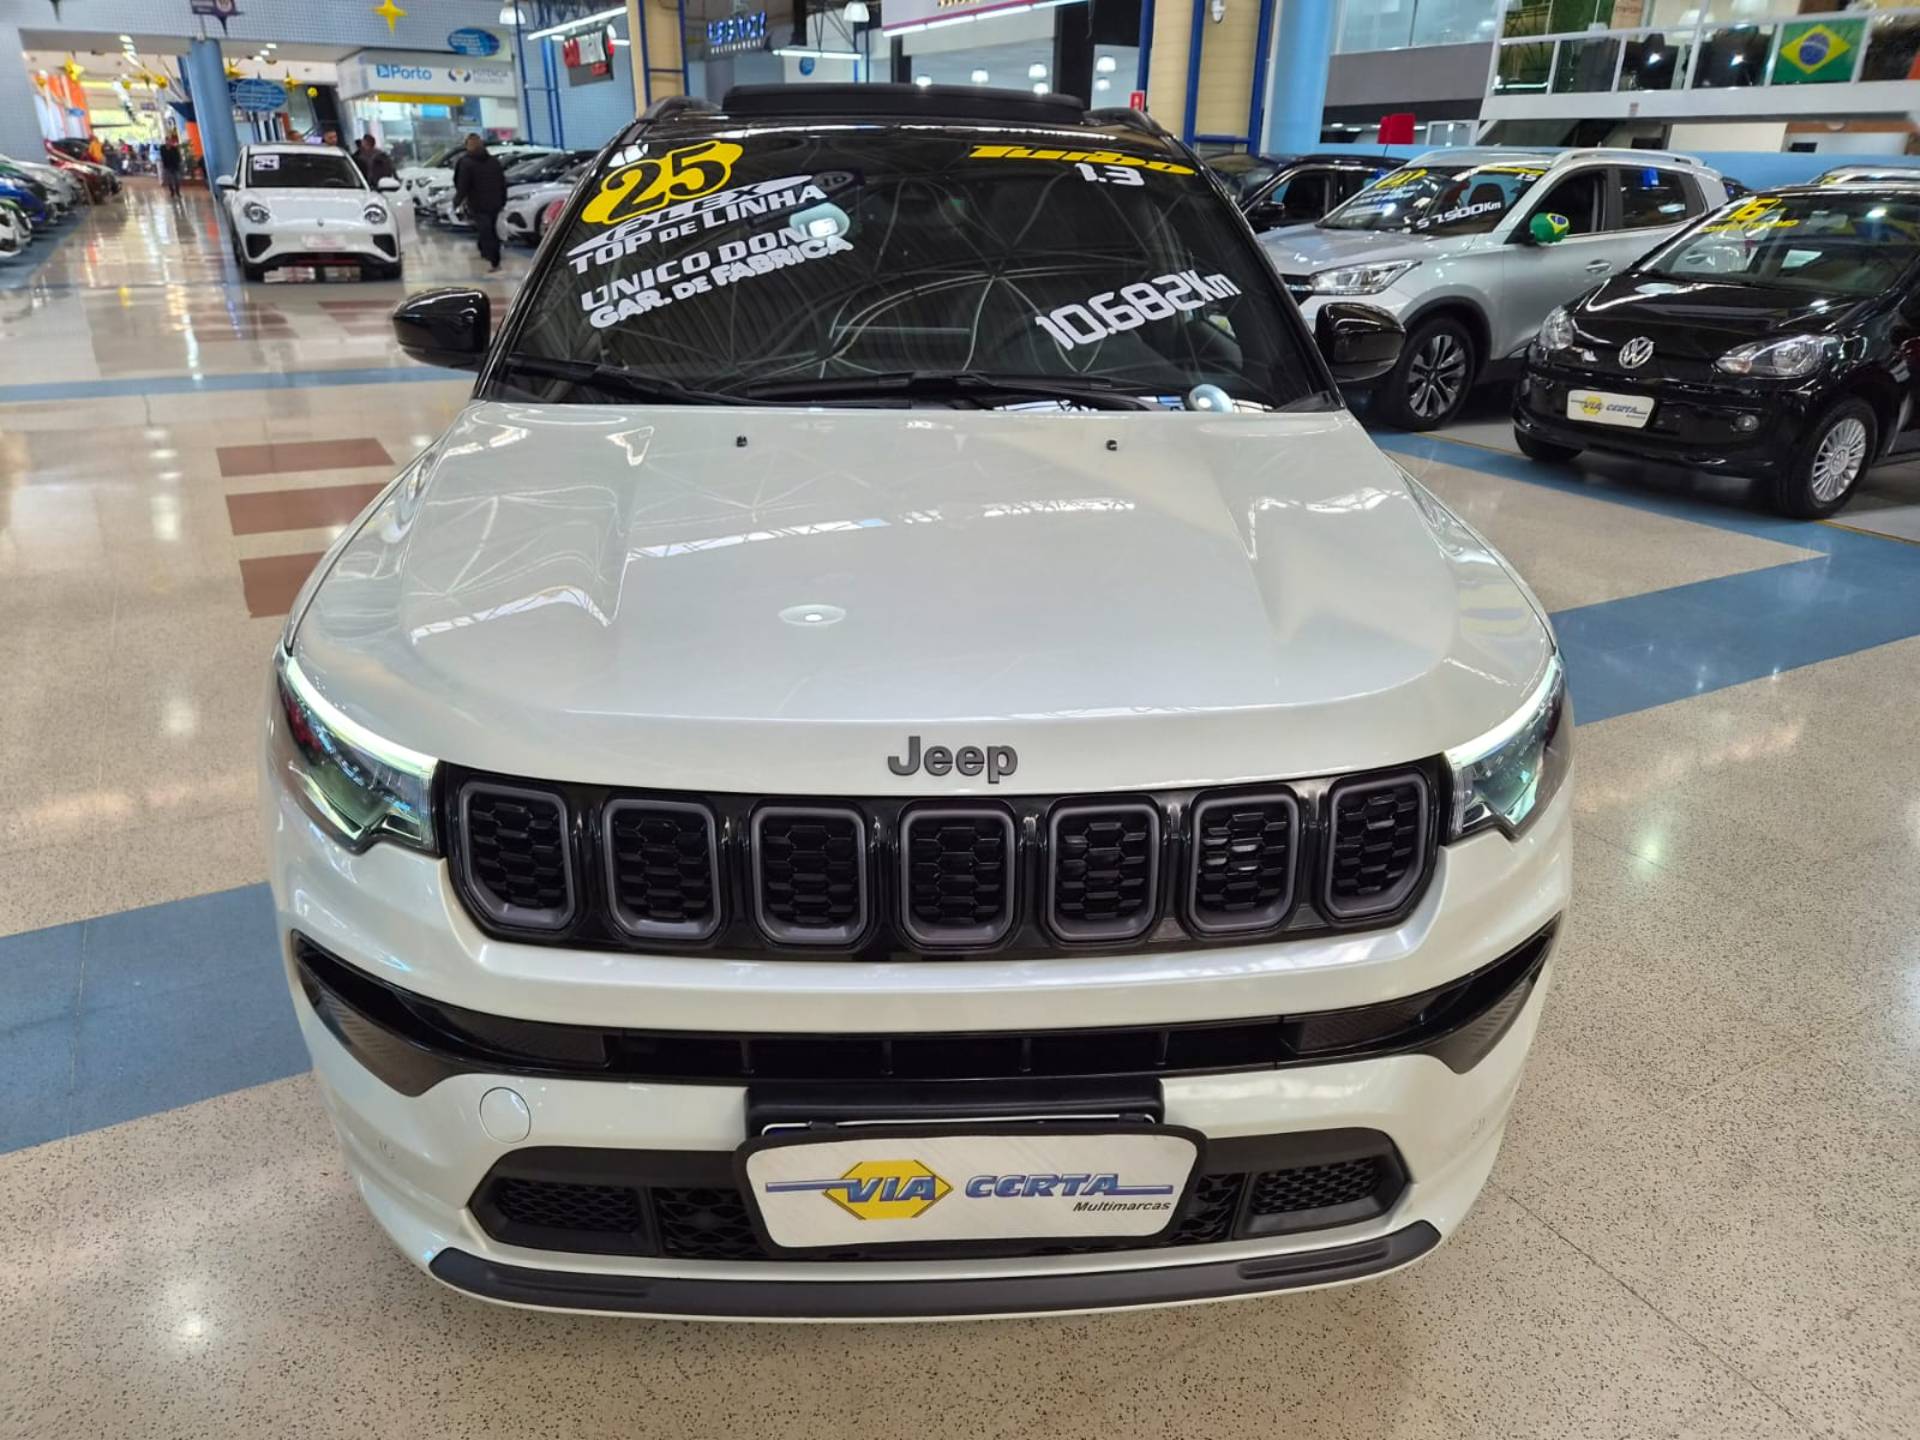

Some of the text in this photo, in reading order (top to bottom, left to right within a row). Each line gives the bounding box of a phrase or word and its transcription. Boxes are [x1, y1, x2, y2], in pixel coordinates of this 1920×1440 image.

[391, 64, 432, 81] Porto
[601, 140, 732, 223] 25
[1074, 163, 1145, 186] 1.3
[569, 184, 828, 274] TOP DE LINHA
[580, 251, 711, 311] UNICO
[589, 235, 854, 329] GAR. DE FABRICA
[888, 736, 1018, 784] Jeep
[843, 1173, 1123, 1203] VIA CERTA
[1072, 1200, 1172, 1213] Multimarcas
